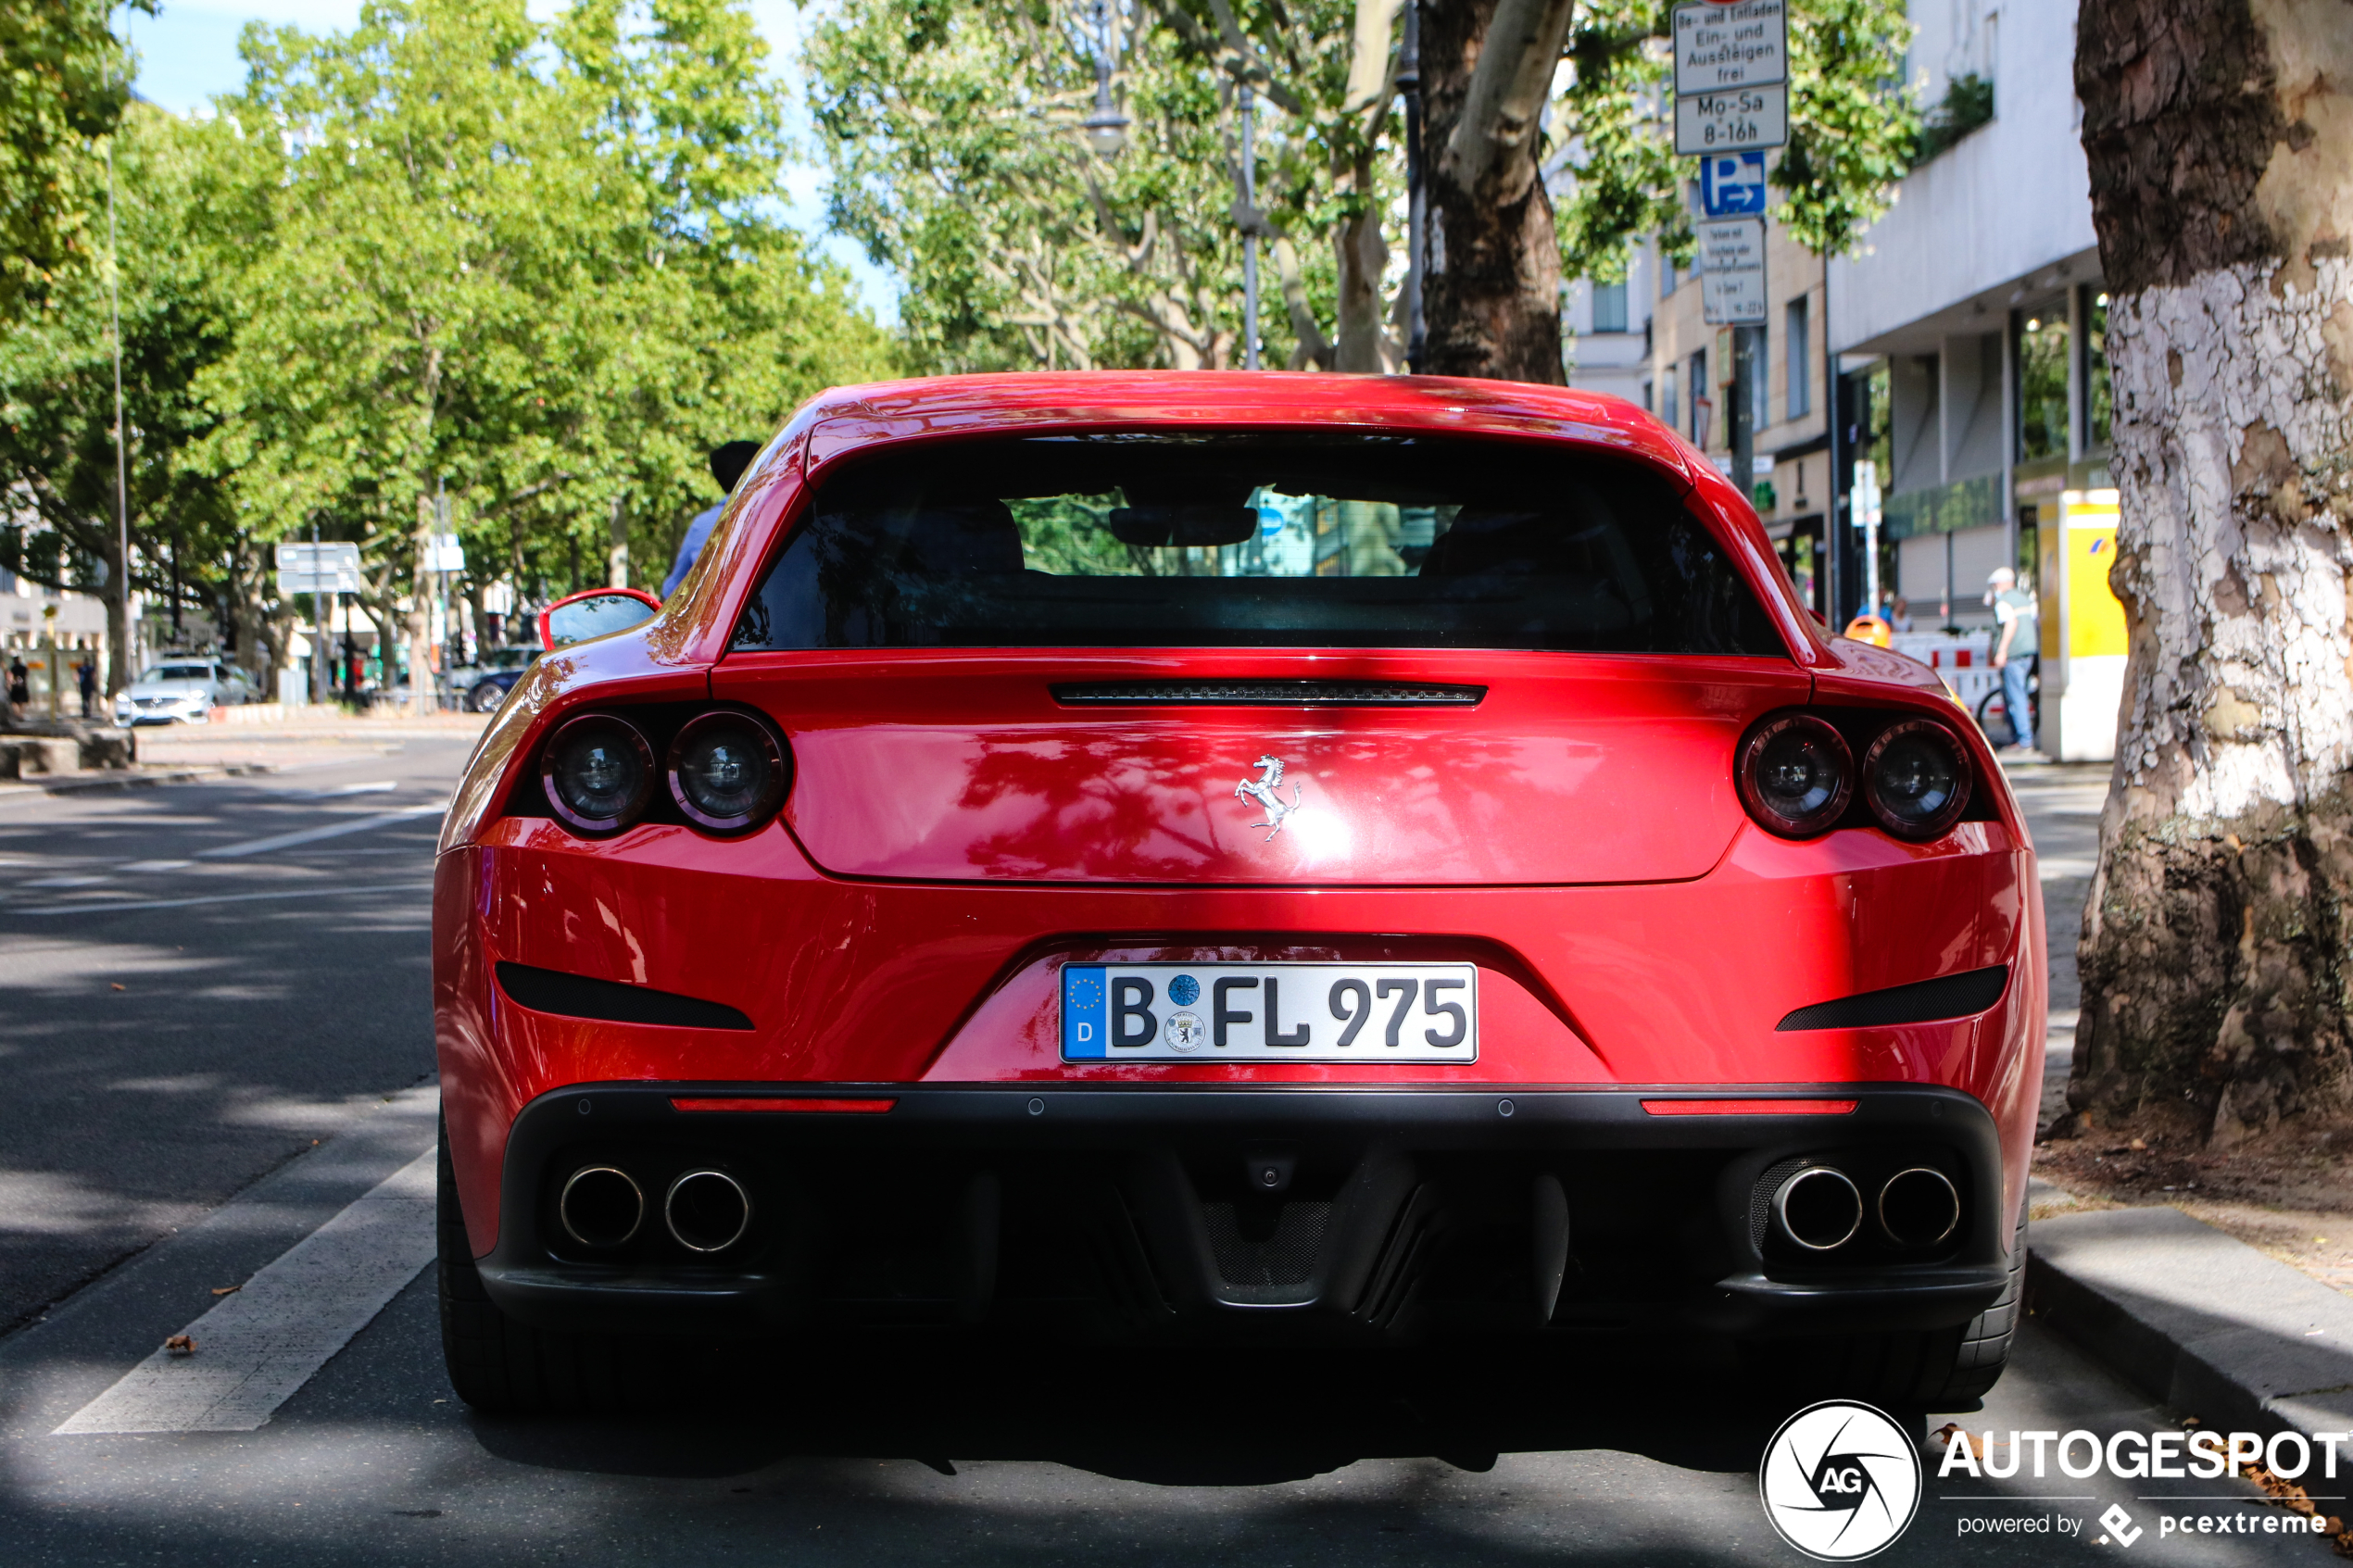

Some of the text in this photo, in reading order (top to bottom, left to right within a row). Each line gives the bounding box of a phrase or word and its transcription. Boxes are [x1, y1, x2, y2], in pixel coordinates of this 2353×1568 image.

[1678, 3, 1780, 30] Be- und Entladen
[1695, 23, 1764, 46] Ein- und
[1687, 44, 1775, 68] Aussteigen
[1718, 66, 1744, 82] frei
[1697, 91, 1763, 117] Mo-Sa
[1112, 975, 1467, 1048] B FL 975
[1077, 1022, 1093, 1042] D
